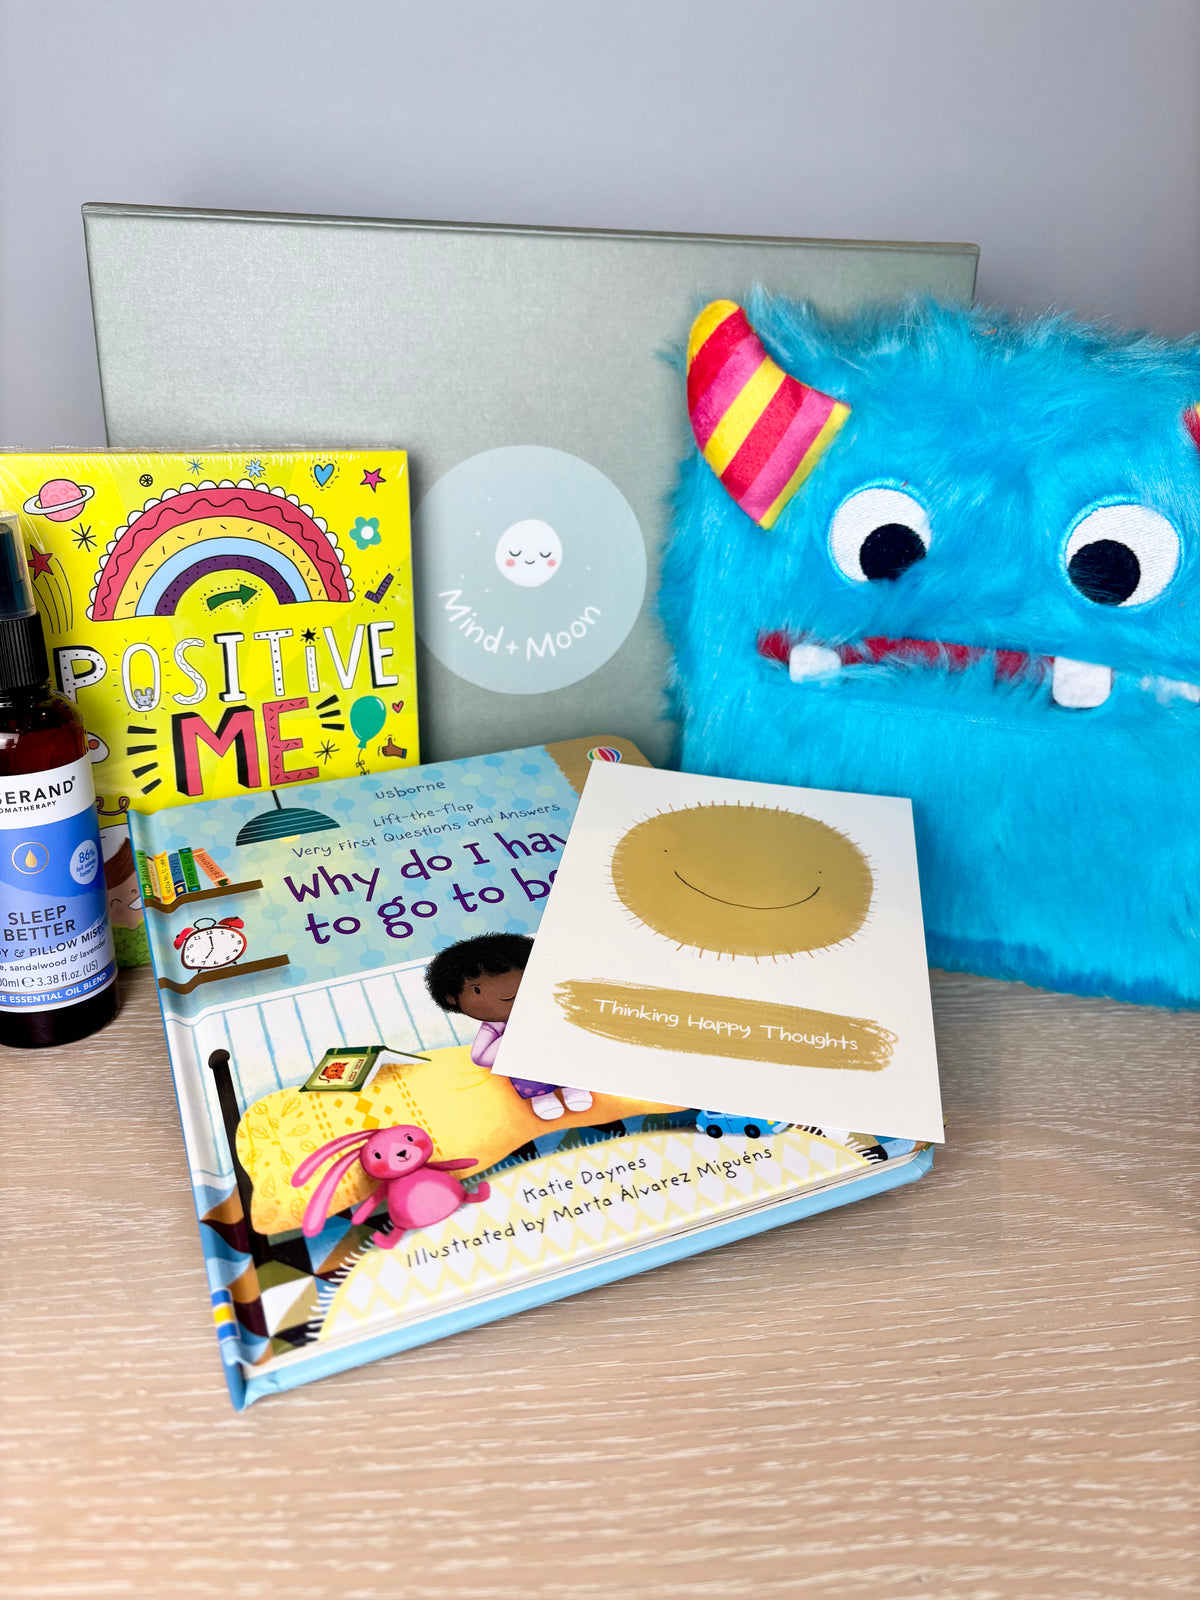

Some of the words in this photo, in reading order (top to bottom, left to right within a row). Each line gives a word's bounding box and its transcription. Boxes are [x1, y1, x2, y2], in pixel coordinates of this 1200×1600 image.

[438, 589, 504, 655] Mind
[526, 605, 602, 661] Moon
[170, 697, 320, 797] ME
[0, 780, 73, 804] ERAND
[375, 779, 447, 801] Usborne
[292, 844, 332, 859] Very
[338, 836, 377, 852] First
[382, 820, 462, 843] Questions
[467, 814, 495, 828] and
[499, 802, 561, 822] Answers
[372, 801, 475, 829] Lift-the-flap
[283, 865, 381, 903] Why
[400, 849, 453, 881] do
[463, 842, 491, 866] I
[3, 919, 76, 941] BETTER
[8, 905, 67, 926] SLEEP
[304, 912, 361, 945] to
[377, 896, 439, 939] go
[452, 883, 505, 913] to
[0, 948, 9, 957] Y
[14, 948, 25, 958] &
[29, 938, 78, 957] PILLOW
[9, 957, 67, 972] sandalwood
[37, 975, 60, 987] 3.38
[82, 959, 99, 976] (US)
[10, 992, 63, 1004] ESSENTIAL
[65, 987, 82, 996] OIL
[83, 972, 107, 990] BLEND
[593, 998, 679, 1027] Thinking
[688, 1014, 752, 1039] Happy
[759, 1024, 859, 1051] Thoughts
[523, 1177, 574, 1204] Katie
[580, 1156, 647, 1189] Daynes
[406, 1222, 516, 1268] Illustrated
[524, 1216, 546, 1238] by
[553, 1195, 613, 1223] Marta
[621, 1171, 692, 1202] Álvarez
[696, 1147, 774, 1179] Miguéns
